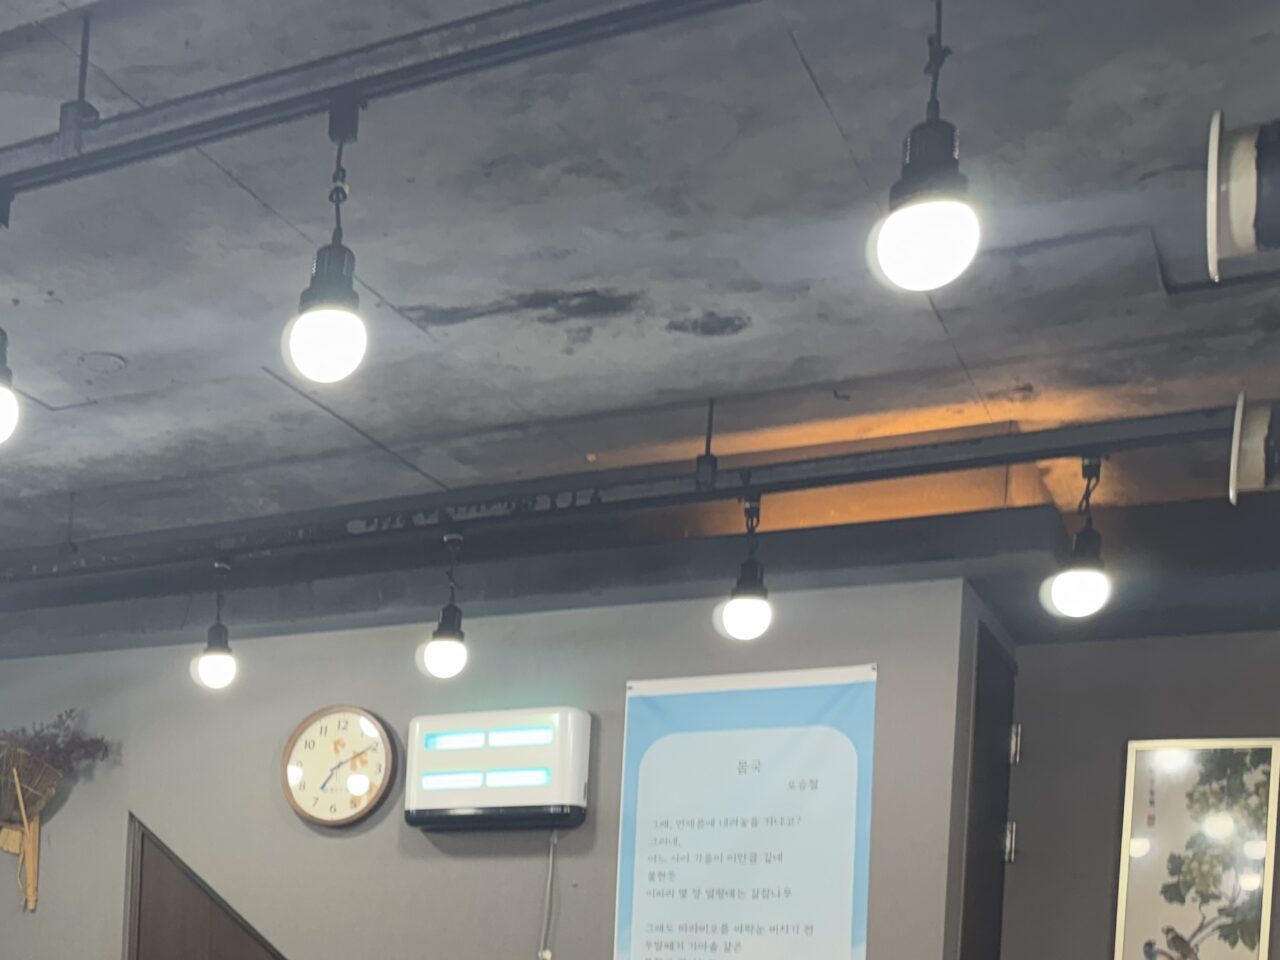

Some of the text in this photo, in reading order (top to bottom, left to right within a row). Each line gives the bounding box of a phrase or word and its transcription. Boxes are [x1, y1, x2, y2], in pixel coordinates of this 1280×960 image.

[319, 725, 328, 736] 11
[337, 719, 349, 731] 12
[304, 739, 316, 751] 10
[312, 797, 319, 807] 7
[329, 804, 337, 814] 6
